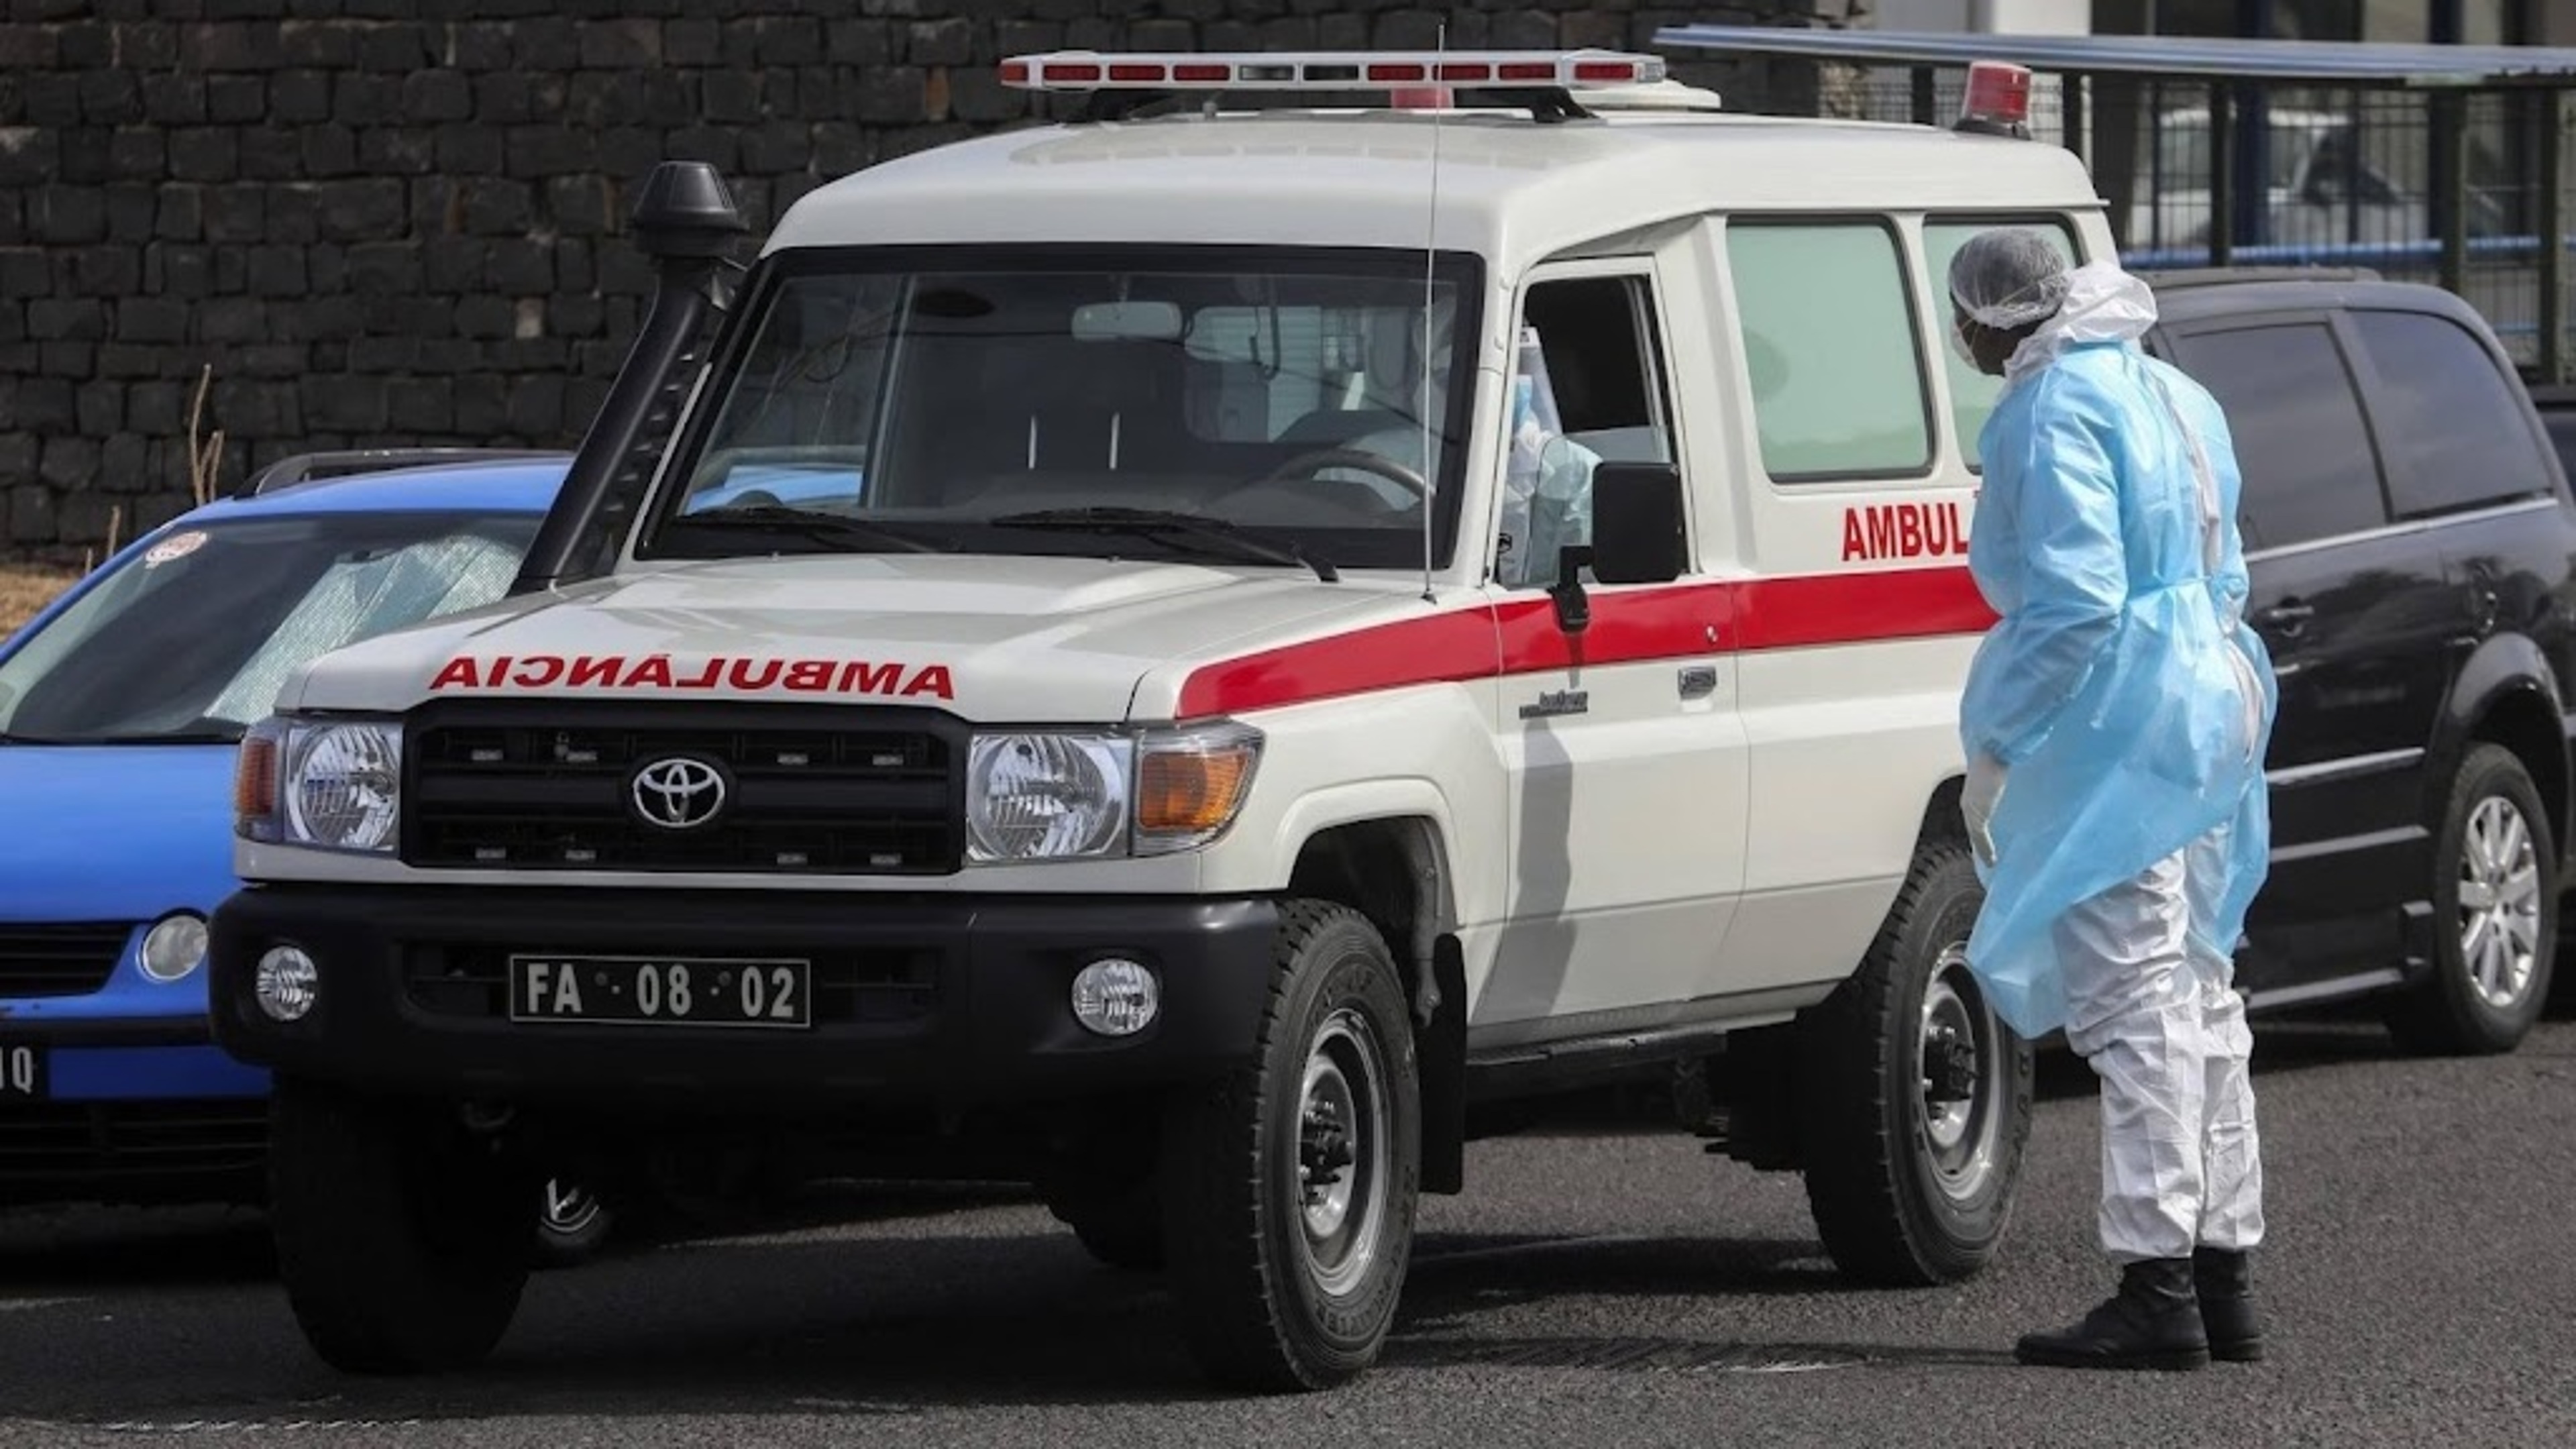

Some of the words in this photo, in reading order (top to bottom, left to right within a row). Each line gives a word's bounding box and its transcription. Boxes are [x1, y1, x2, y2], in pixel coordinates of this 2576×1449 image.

[1842, 491, 1980, 561] AMBUL
[527, 963, 582, 1013] FA
[637, 964, 692, 1016] 08
[741, 965, 794, 1017] 02
[0, 1046, 34, 1094] Q
